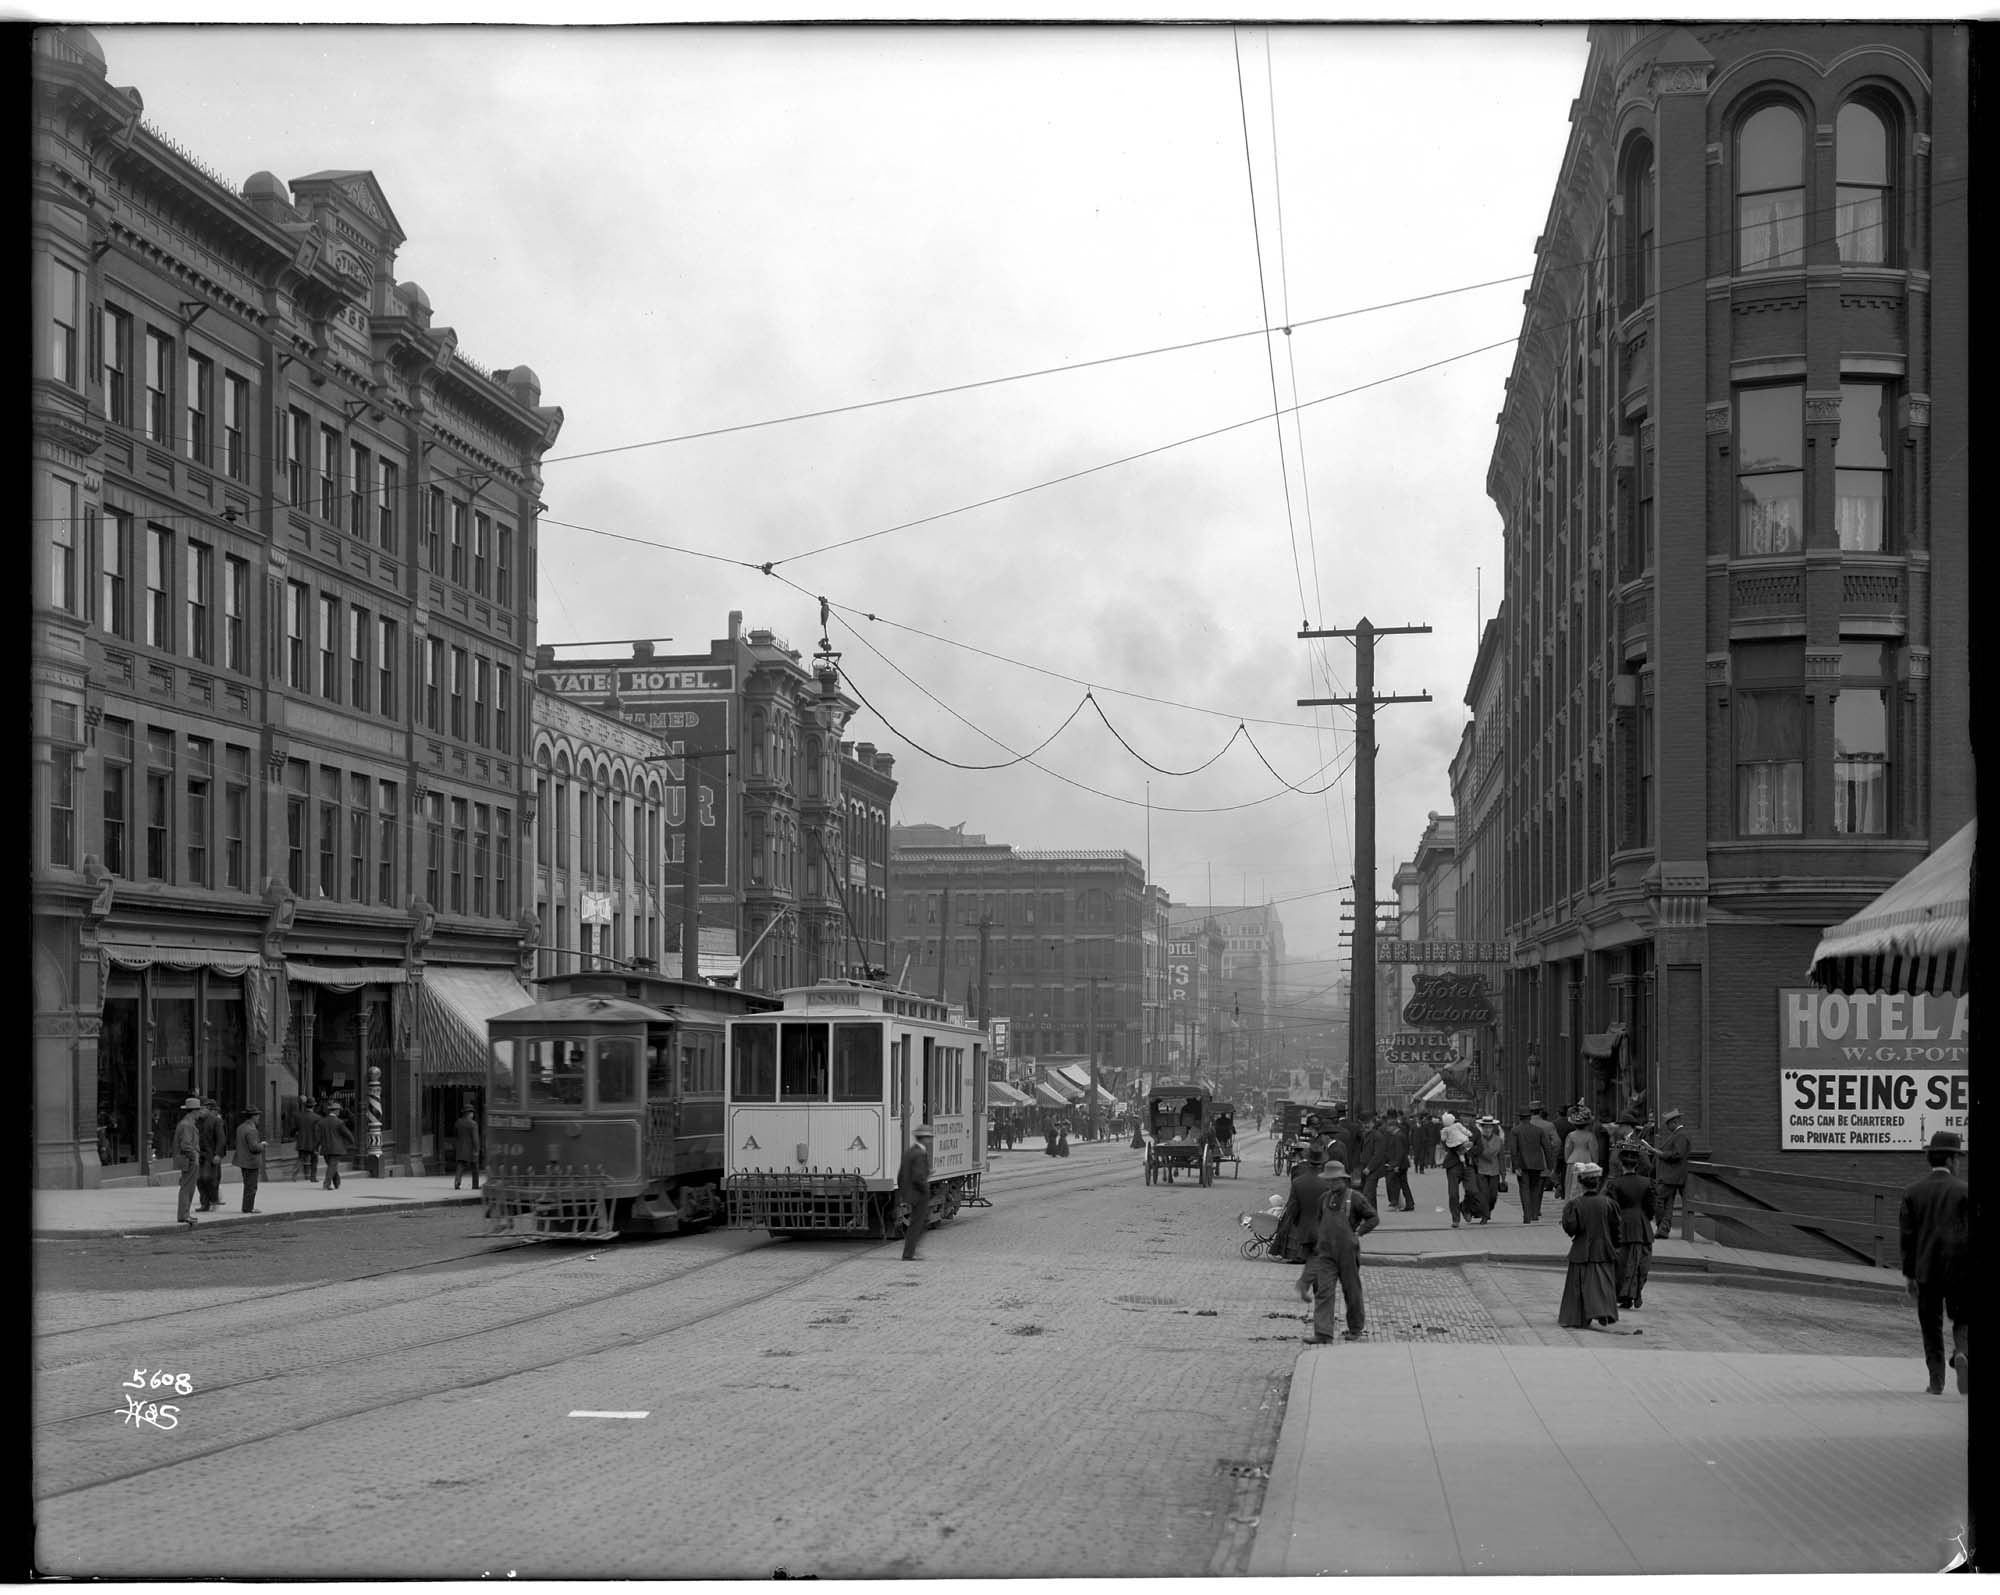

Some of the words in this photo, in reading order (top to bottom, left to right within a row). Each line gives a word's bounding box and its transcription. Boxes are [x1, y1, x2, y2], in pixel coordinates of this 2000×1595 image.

[631, 671, 718, 690] HOTEL.
[1379, 942, 1509, 961] ARLINGTON
[1416, 979, 1479, 998] Hotel
[1407, 1001, 1489, 1021] Victoria
[1788, 993, 1941, 1048] HOTEL
[1396, 1035, 1449, 1047] HOTEL
[1390, 1051, 1454, 1062] SENECA
[1790, 1115, 1815, 1127] CARS
[1817, 1115, 1836, 1127] CAN
[1838, 1115, 1849, 1127] BE
[1850, 1114, 1905, 1127] CHARTERED
[741, 1135, 761, 1150] A
[848, 1135, 868, 1150] A
[1807, 1131, 1846, 1144] PRIVATE
